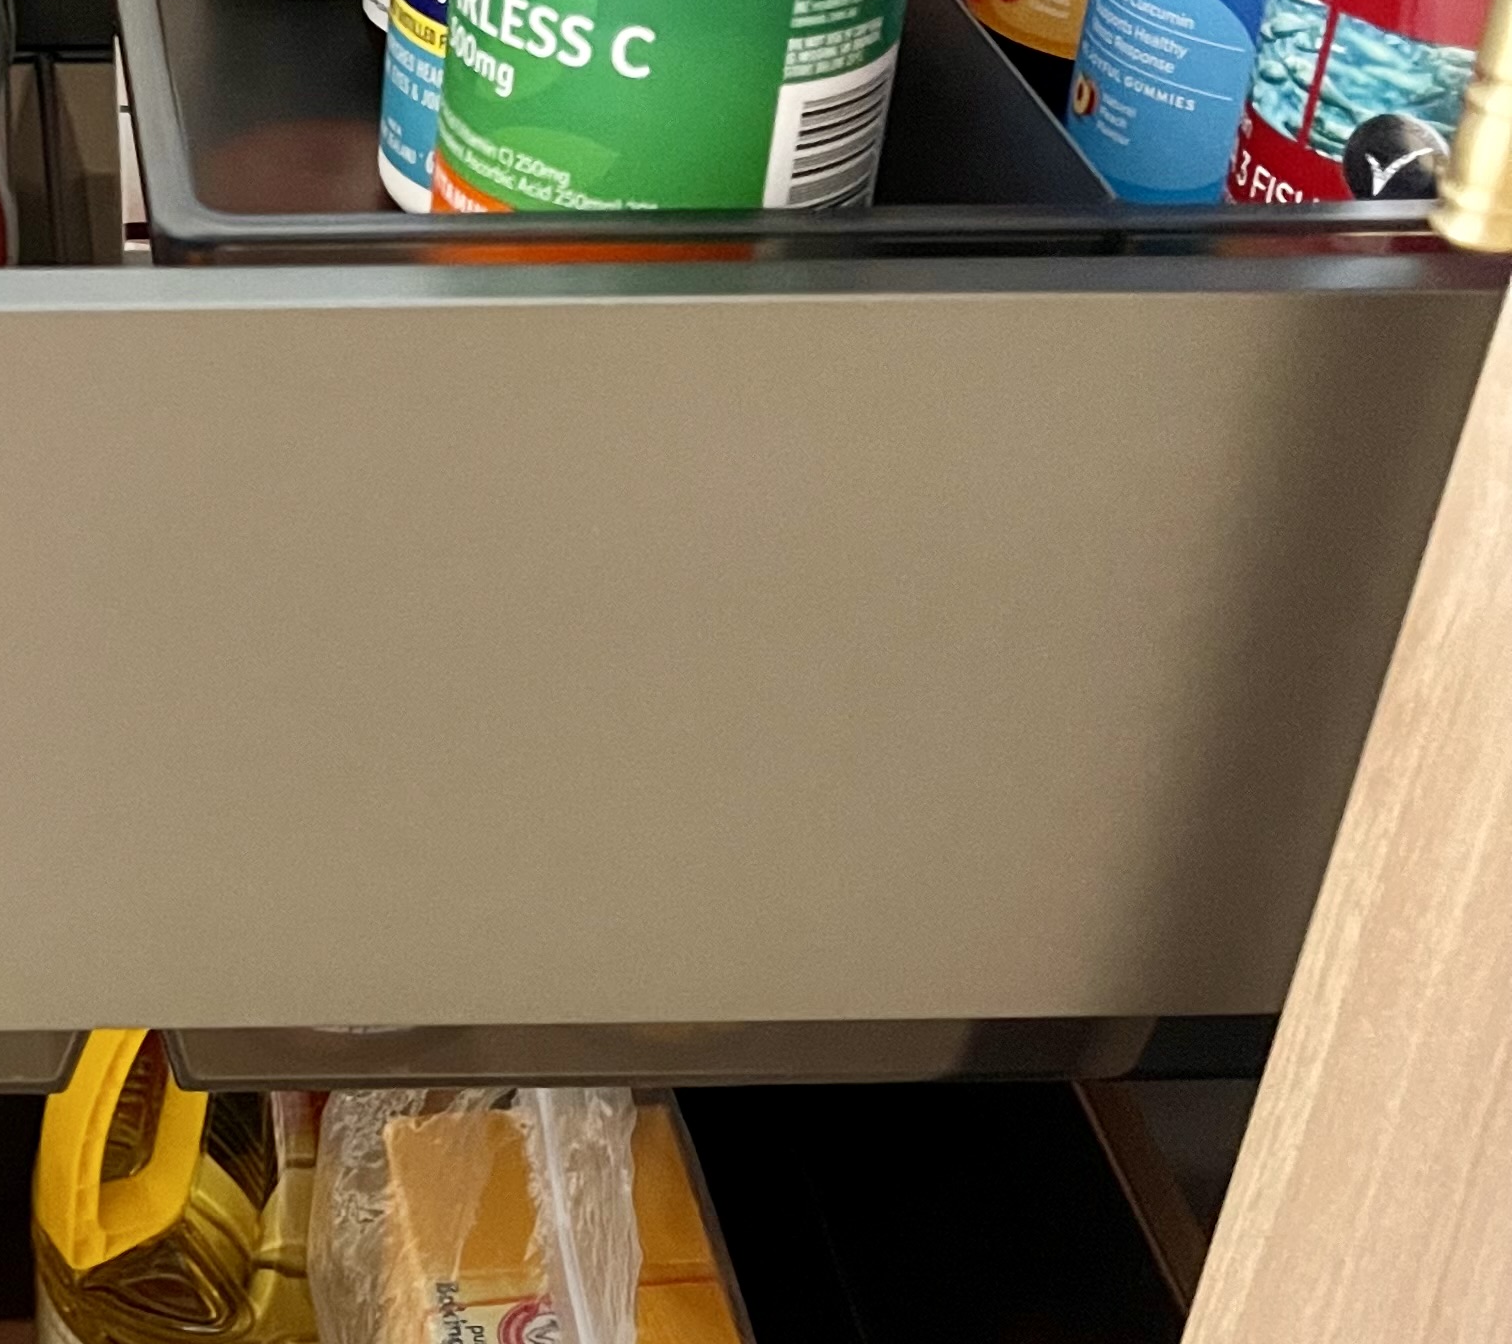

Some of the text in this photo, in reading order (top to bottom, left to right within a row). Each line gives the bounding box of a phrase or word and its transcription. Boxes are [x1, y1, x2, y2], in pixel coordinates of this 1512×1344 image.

[611, 25, 656, 79] C
[1123, 75, 1196, 112] GUMMIES
[1236, 150, 1251, 186] 3
